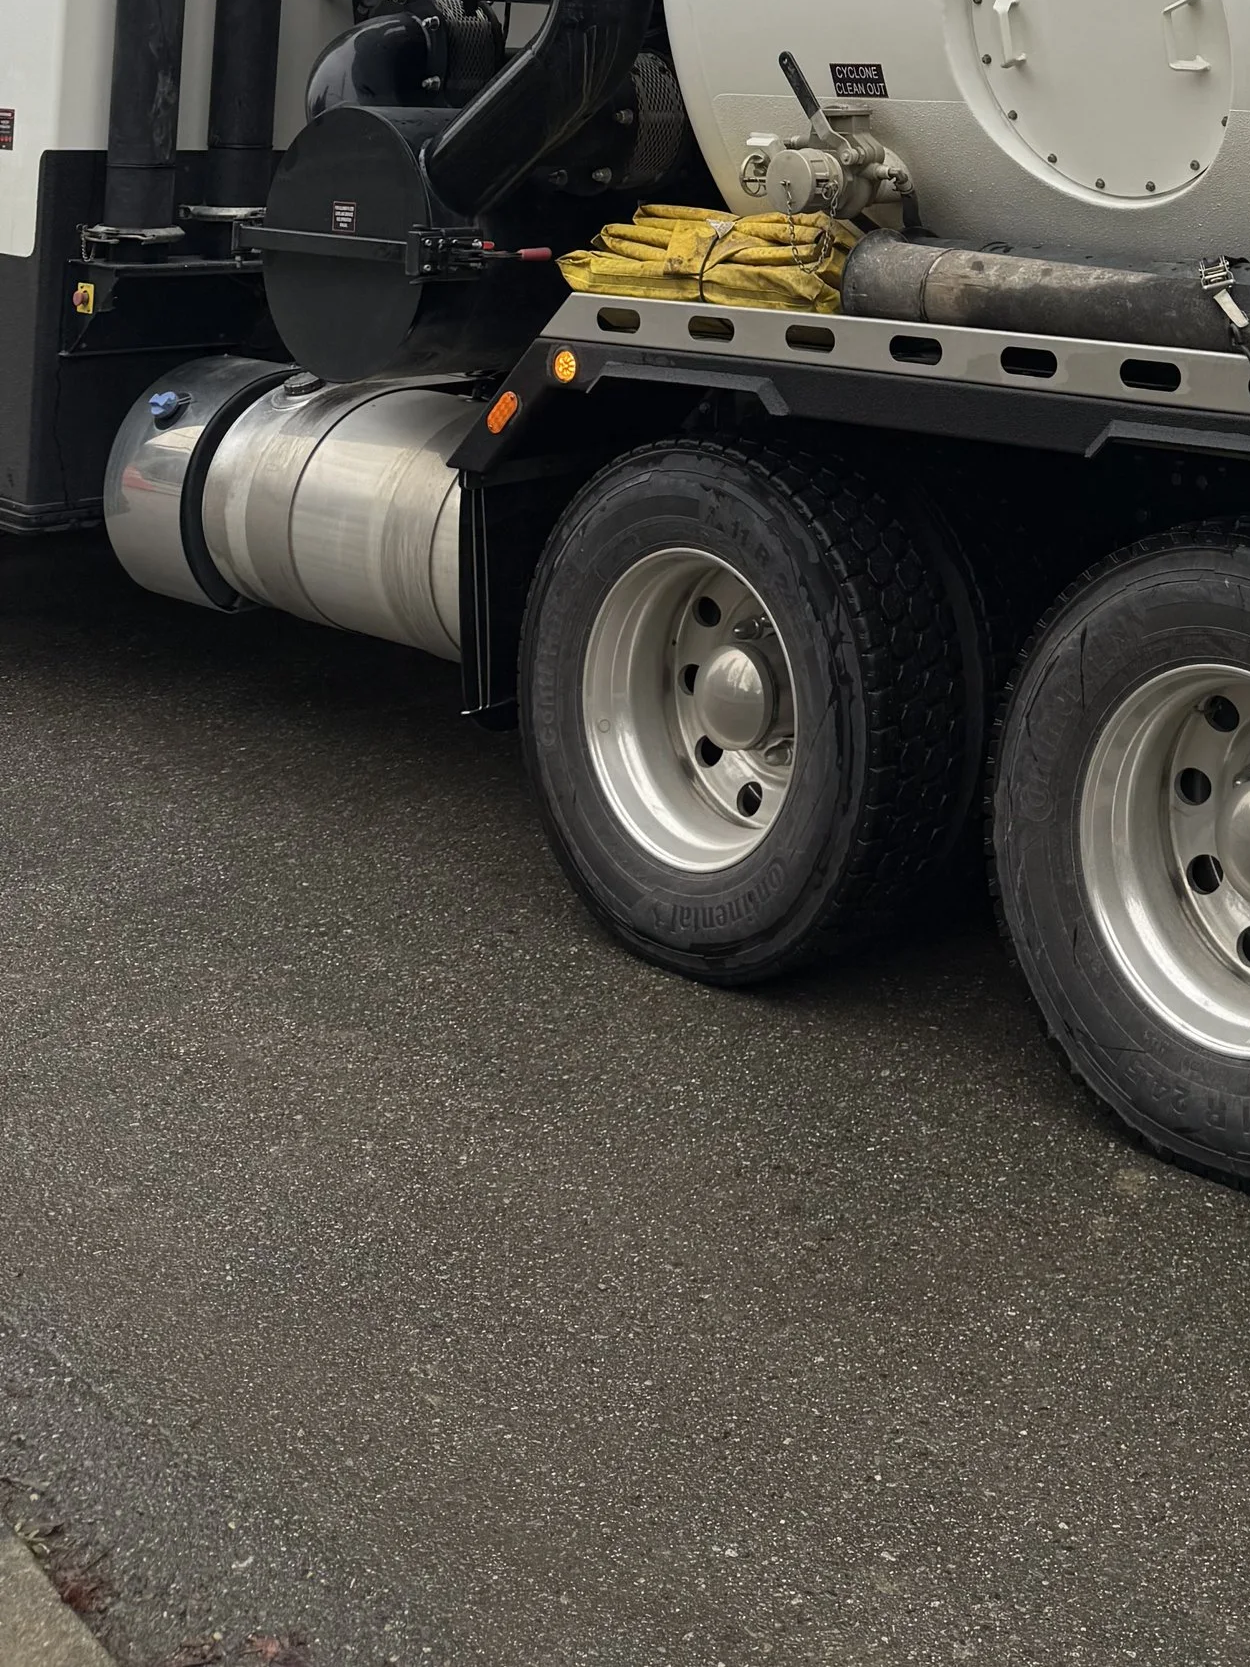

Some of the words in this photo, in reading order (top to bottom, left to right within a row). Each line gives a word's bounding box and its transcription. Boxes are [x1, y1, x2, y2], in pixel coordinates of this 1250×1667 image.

[835, 66, 879, 79] CYCLONE
[835, 82, 866, 95] CLEAN
[866, 82, 886, 95] OUT
